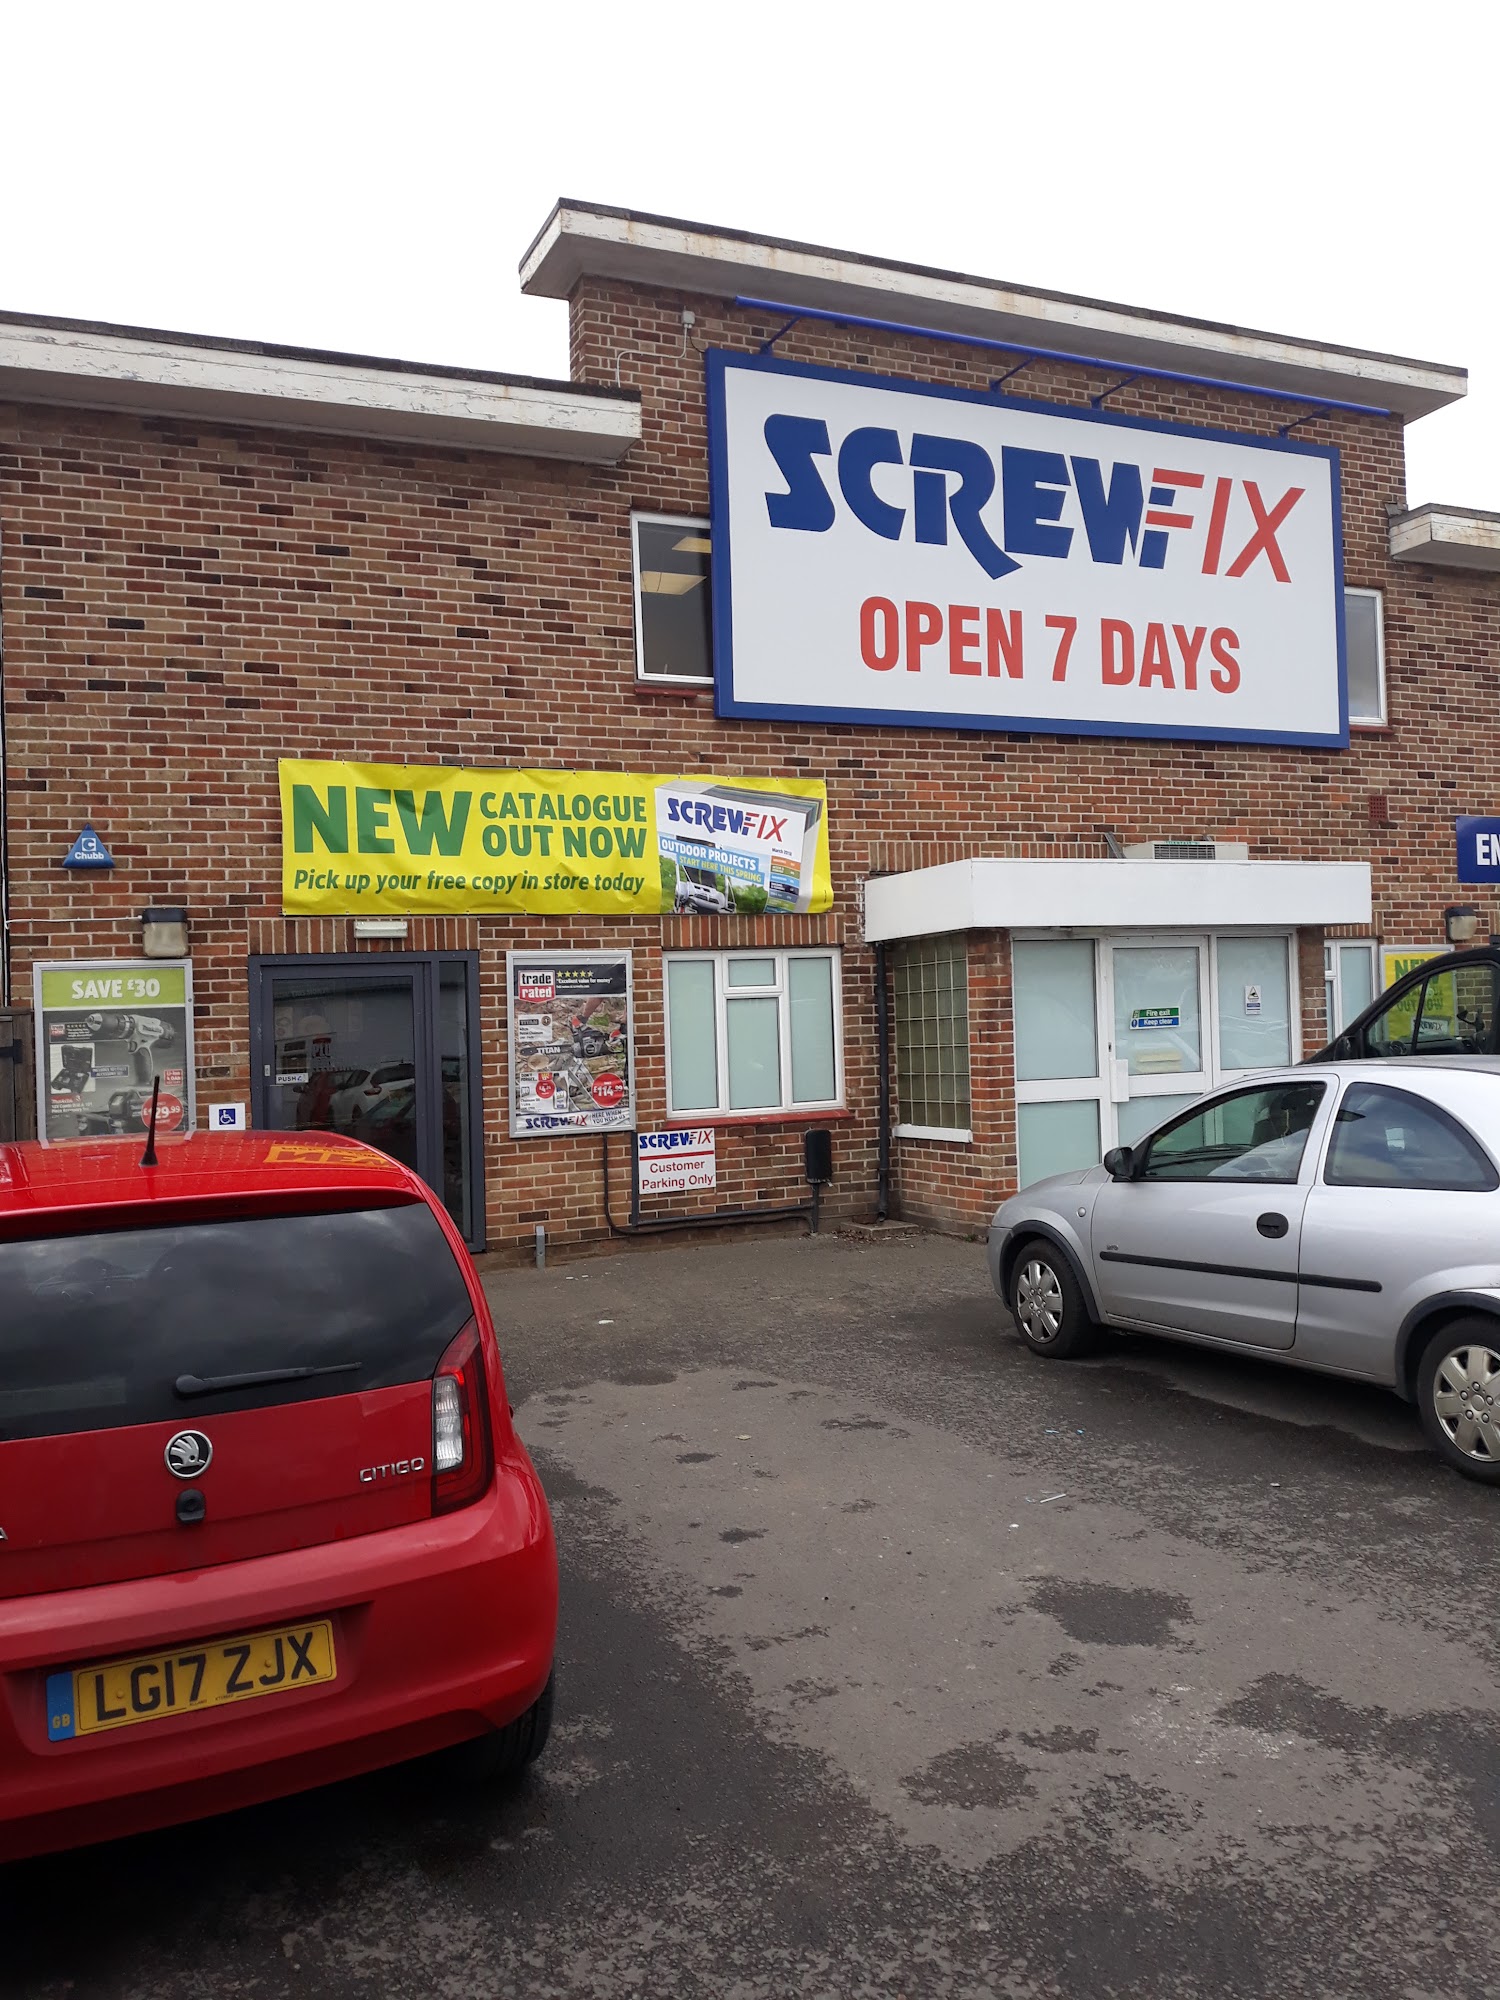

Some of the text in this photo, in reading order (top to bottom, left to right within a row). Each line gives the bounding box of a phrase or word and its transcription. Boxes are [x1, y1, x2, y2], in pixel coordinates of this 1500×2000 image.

[763, 413, 1306, 582] SCREWFIX
[859, 596, 1241, 693] OPEN 7 DAYS
[479, 791, 647, 823] CATALOGUE
[292, 784, 473, 857] NEW
[667, 797, 788, 842] SCREWFIX
[482, 824, 648, 859] OUT NOW
[74, 851, 105, 860] Chubb
[661, 838, 757, 871] OUTDOOR PROJECTS
[679, 855, 700, 867] START
[701, 860, 718, 870] HERE
[720, 864, 735, 875] THIS
[735, 868, 762, 883] SPRING
[294, 869, 645, 895] Pick up your free copy in store today
[71, 978, 161, 999] SAVE £30
[521, 973, 552, 984] trade
[521, 987, 552, 998] rated
[1143, 1018, 1158, 1026] Keep
[1146, 1009, 1159, 1017] Fire
[537, 1047, 561, 1055] TITAN
[593, 1085, 623, 1097] £114.99
[526, 1114, 589, 1129] SCREWFIX
[639, 1130, 713, 1150] SCREWFIX
[650, 1161, 705, 1173] Customer
[642, 1174, 713, 1189] Parking Only
[359, 1457, 425, 1482] CITIGO
[95, 1631, 317, 1722] LG17 ZJX
[52, 1713, 71, 1728] GB
